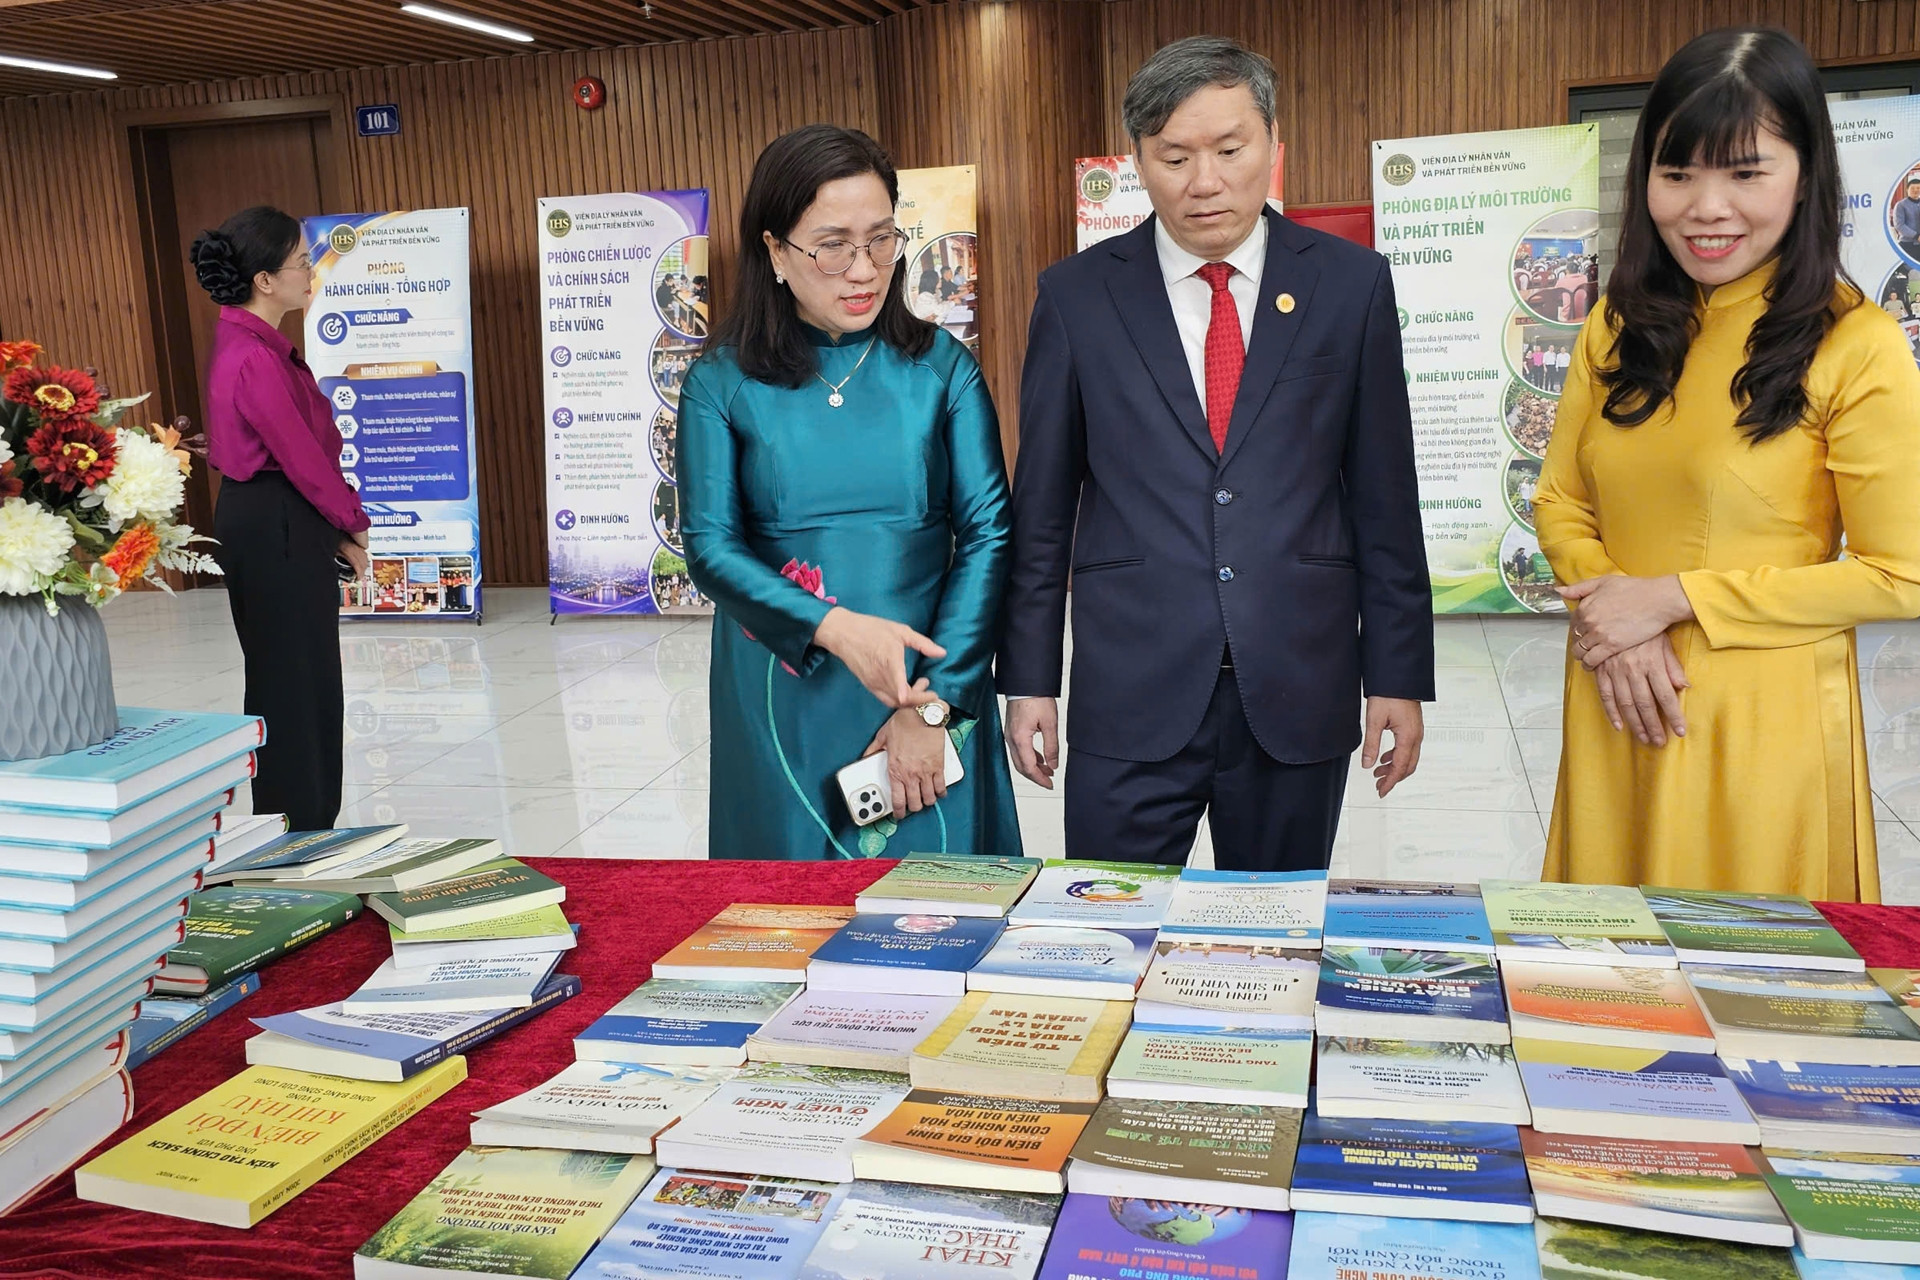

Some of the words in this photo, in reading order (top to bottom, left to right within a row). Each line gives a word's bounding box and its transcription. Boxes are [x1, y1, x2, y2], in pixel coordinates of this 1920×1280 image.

[366, 112, 389, 129] 101
[1382, 197, 1431, 215] PHÒNG
[1434, 199, 1458, 214] ĐỊA
[1461, 192, 1476, 208] LÝ
[1479, 191, 1508, 208] MÔI
[1511, 186, 1572, 205] TRƯỜNG
[550, 218, 569, 228] IHS
[1085, 213, 1130, 231] PHÒNG
[1382, 224, 1400, 240] VÀ
[1403, 221, 1439, 239] PHÁT
[1442, 215, 1484, 236] TRIỂN
[334, 234, 353, 244] IHS
[548, 248, 585, 264] PHÒNG
[588, 243, 621, 262] CHIẾN
[623, 244, 651, 263] LƯỢC
[1413, 247, 1452, 264] VỮNG
[367, 260, 405, 275] PHÒNG
[548, 273, 563, 287] VÀ
[565, 271, 598, 285] CHÍNH
[600, 269, 629, 284] SÁCH
[325, 282, 354, 297] HÀNH
[356, 280, 389, 295] CHÍNH
[397, 276, 426, 294] TỔNG
[428, 278, 450, 295] HỢP
[549, 294, 578, 310] PHÁT
[580, 290, 612, 308] TRIỂN
[355, 311, 376, 323] CHỨC
[377, 310, 399, 322] NĂNG
[1415, 311, 1443, 324] CHỨC
[1445, 310, 1473, 322] NĂNG
[550, 315, 571, 332] BỀN
[574, 316, 604, 331] VỮNG
[576, 349, 598, 361] CHỨC
[599, 349, 621, 360] NĂNG
[1416, 371, 1450, 383] NHIỆM
[1452, 371, 1465, 382] VỤ
[1467, 367, 1499, 380] CHÍNH
[578, 412, 604, 423] NHIỆM
[605, 412, 615, 423] VỤ
[617, 410, 641, 421] CHÍNH
[1419, 499, 1443, 511] ĐỊNH
[1446, 498, 1481, 510] HƯỚNG
[370, 514, 383, 526] ỊNH
[580, 515, 599, 525] ĐỊNH
[601, 513, 629, 524] HƯỚNG
[220, 1094, 283, 1116] HẬU
[734, 1098, 788, 1110] NAM
[795, 1103, 843, 1113] VIỆT
[279, 1105, 347, 1125] KHÍ
[850, 1106, 868, 1116] Ở
[945, 1108, 974, 1118] HÓA
[979, 1109, 1002, 1121] ĐẠI
[184, 1112, 248, 1135] ĐỔI
[919, 1116, 950, 1127] HÓA
[1005, 1112, 1040, 1123] HIỆN
[951, 1119, 1006, 1131] NGHIỆP
[1008, 1125, 1051, 1135] CÔNG
[246, 1126, 321, 1146] BIẾN
[906, 1129, 944, 1141] ĐÌNH
[947, 1134, 973, 1144] GIA
[147, 1140, 183, 1154] SÁCH
[975, 1138, 1002, 1148] ĐỔI
[1005, 1140, 1041, 1151] BIẾN
[185, 1145, 222, 1161] CHÍNH
[224, 1151, 245, 1165] TẠO
[1341, 1148, 1386, 1156] CHUNG
[1387, 1151, 1413, 1160] THỦ
[1415, 1152, 1459, 1162] PHÒNG
[246, 1157, 279, 1170] KIẾN
[1344, 1156, 1375, 1164] NINH
[1377, 1158, 1397, 1166] AN
[1399, 1159, 1435, 1169] SÁCH
[1461, 1155, 1479, 1163] VÀ
[1437, 1162, 1477, 1172] CHÍNH
[435, 1216, 486, 1229] TRƯỜNG
[488, 1221, 510, 1230] MÔI
[512, 1224, 531, 1235] ĐỀ
[532, 1226, 557, 1236] VẤN
[629, 1240, 654, 1250] NHÂN
[943, 1230, 1020, 1251] THÁC
[656, 1244, 679, 1253] CÔNG
[681, 1246, 697, 1256] CỦA
[699, 1249, 719, 1257] VIỆC
[721, 1250, 744, 1259] CÔNG
[746, 1252, 767, 1260] NINH
[918, 1245, 1014, 1269] KHAI
[1327, 1256, 1396, 1268] NGUYÊN
[1402, 1263, 1434, 1272] TÂY
[1440, 1266, 1486, 1276] VÙNG
